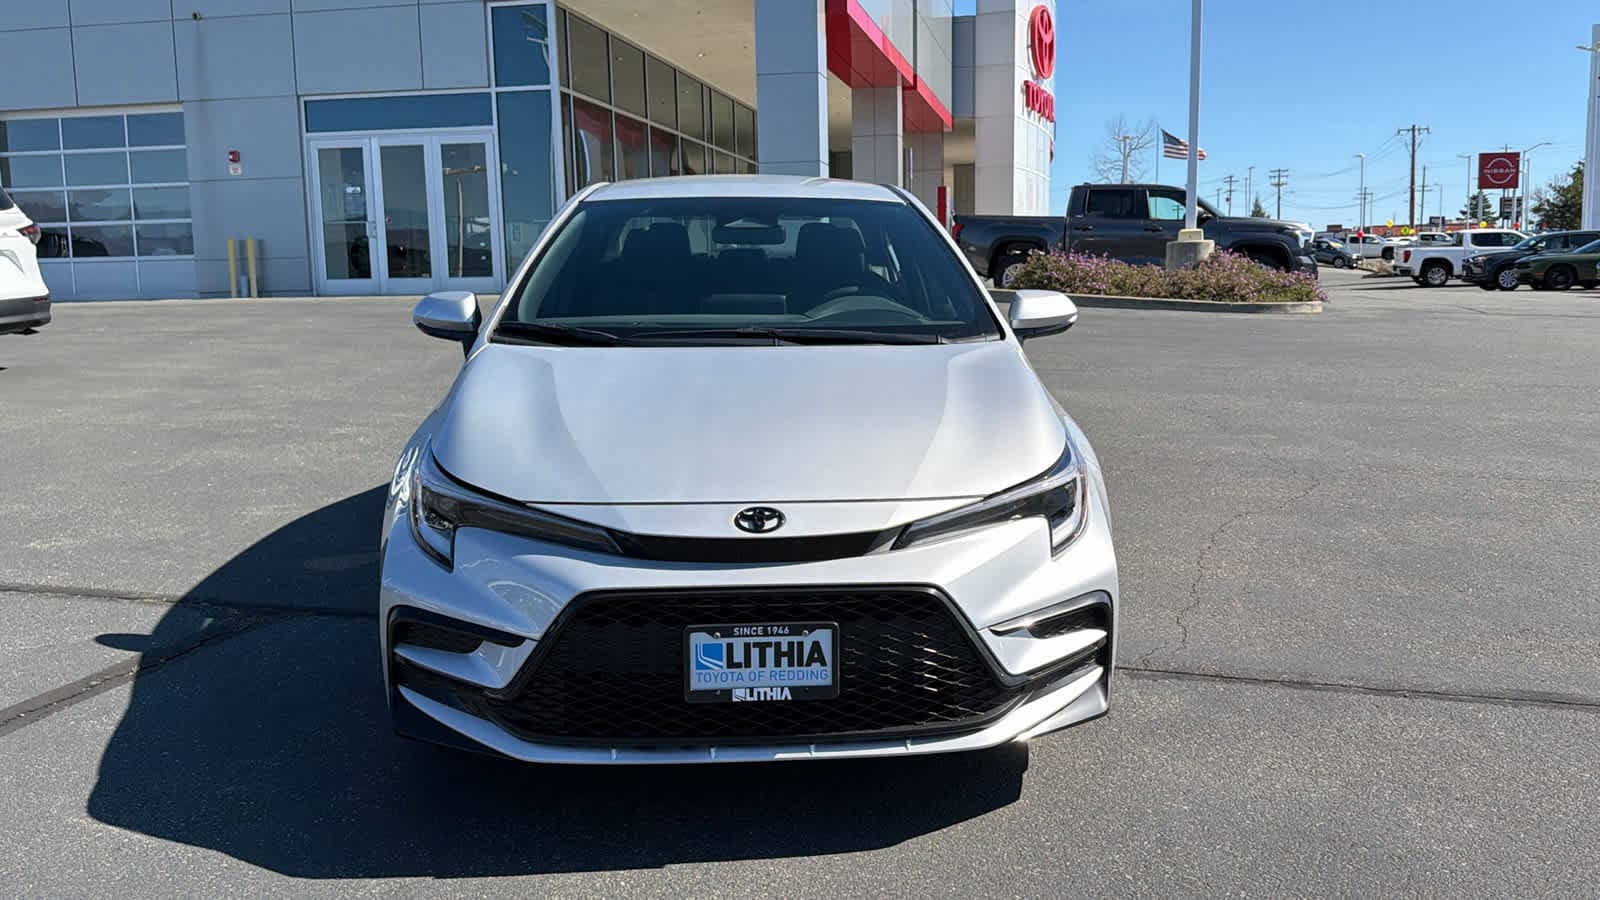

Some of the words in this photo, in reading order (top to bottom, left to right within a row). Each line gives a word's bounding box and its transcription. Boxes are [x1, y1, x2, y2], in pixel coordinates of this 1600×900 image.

[733, 626, 764, 636] SINCE
[767, 626, 790, 636] 1946
[726, 640, 827, 669] LITHIA
[696, 671, 744, 683] TOYOTA
[748, 670, 765, 682] OF
[769, 669, 829, 682] REDDING
[746, 687, 792, 701] LITHIA
